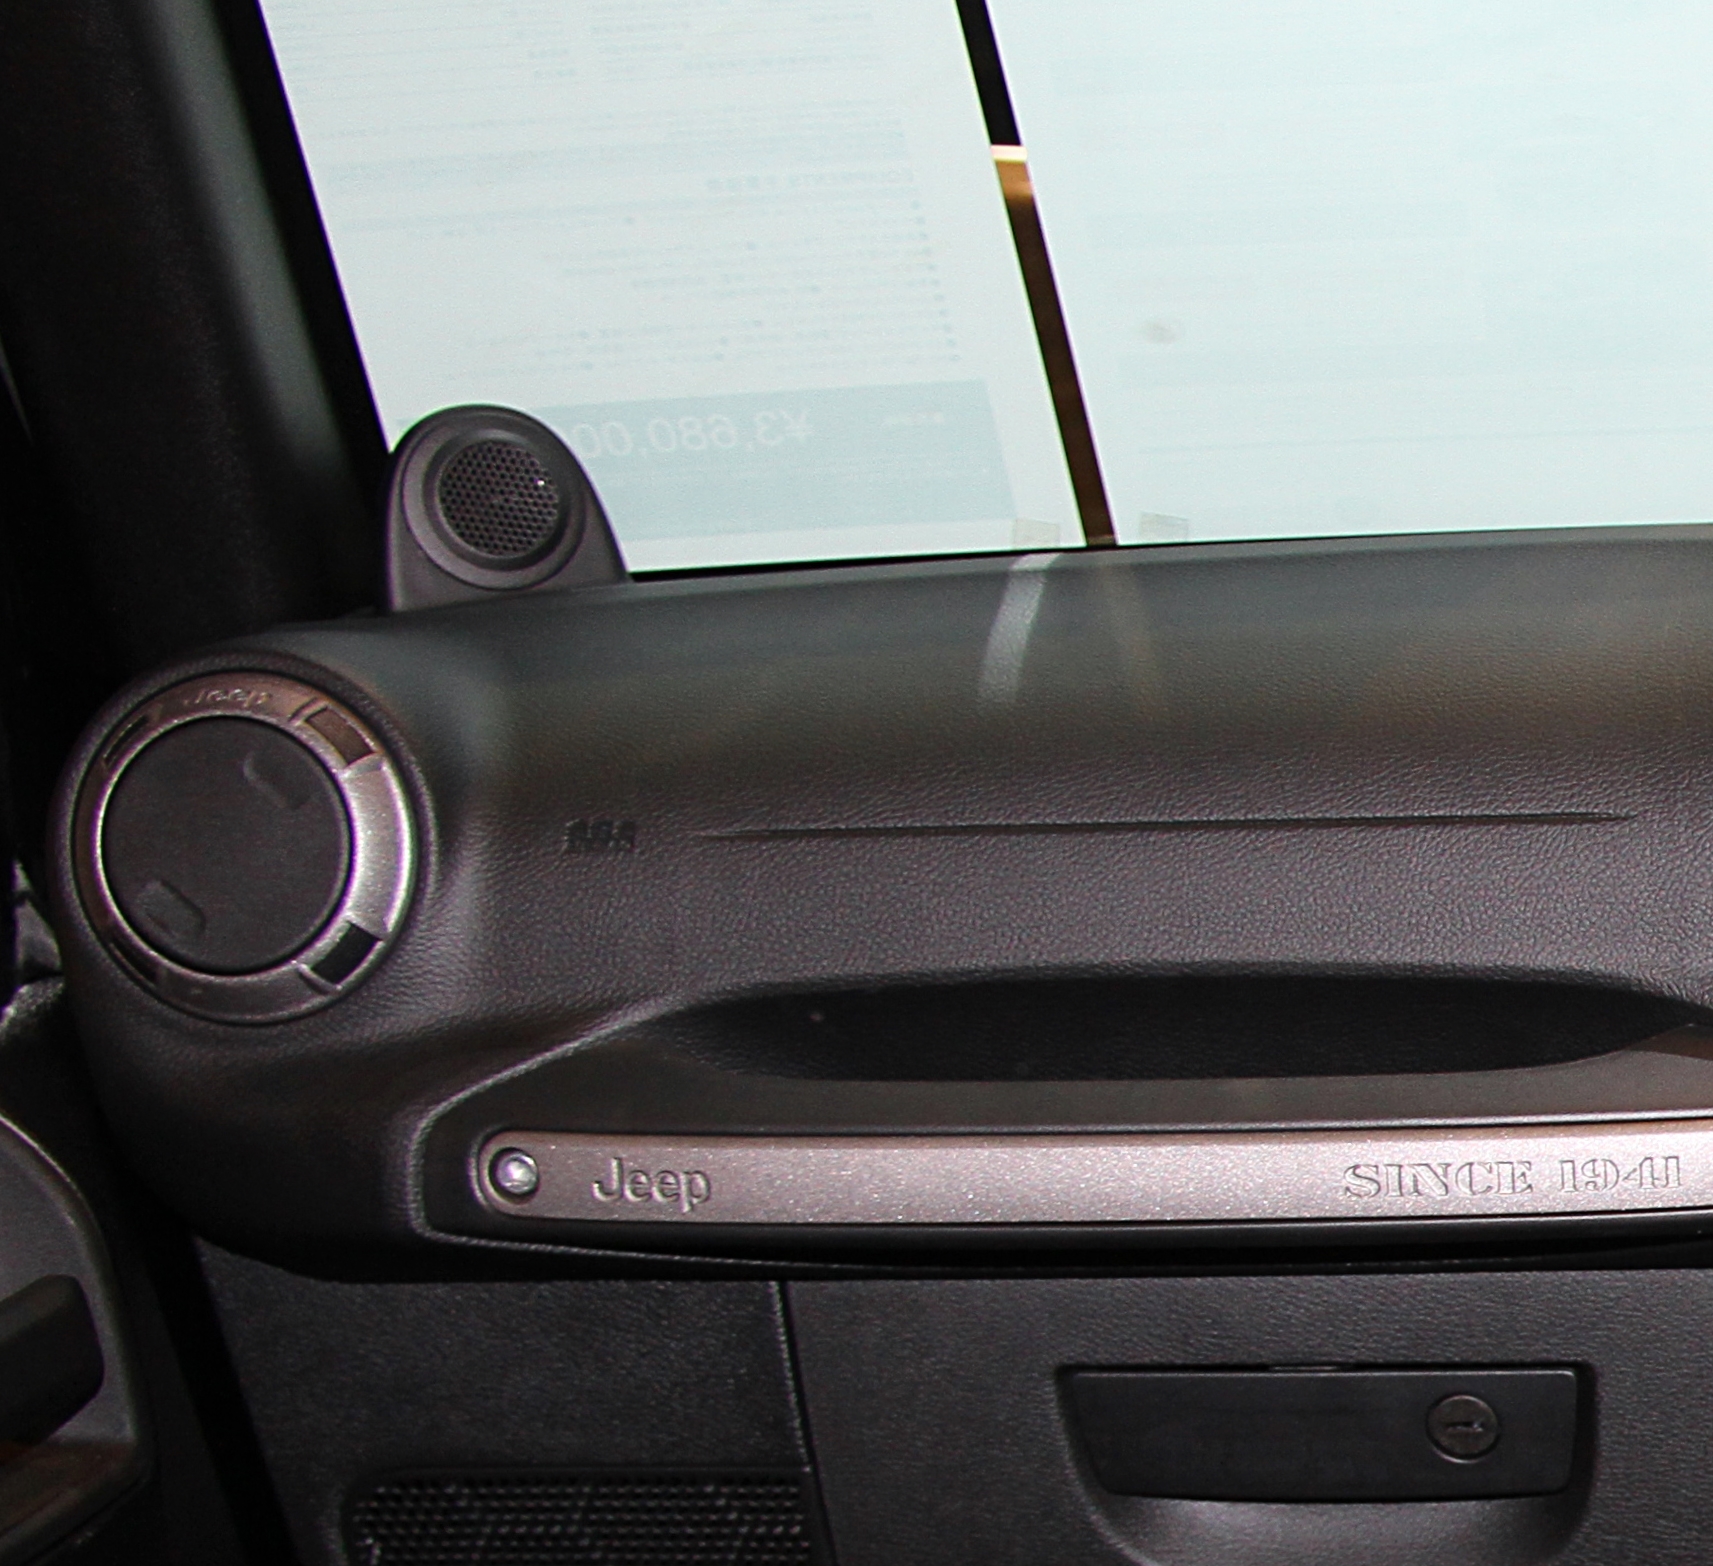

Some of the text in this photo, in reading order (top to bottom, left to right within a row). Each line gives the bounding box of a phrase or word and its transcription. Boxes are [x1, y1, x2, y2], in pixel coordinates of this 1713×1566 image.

[591, 1157, 711, 1214] Jeep
[1343, 1155, 1682, 1199] SINCE 1941
